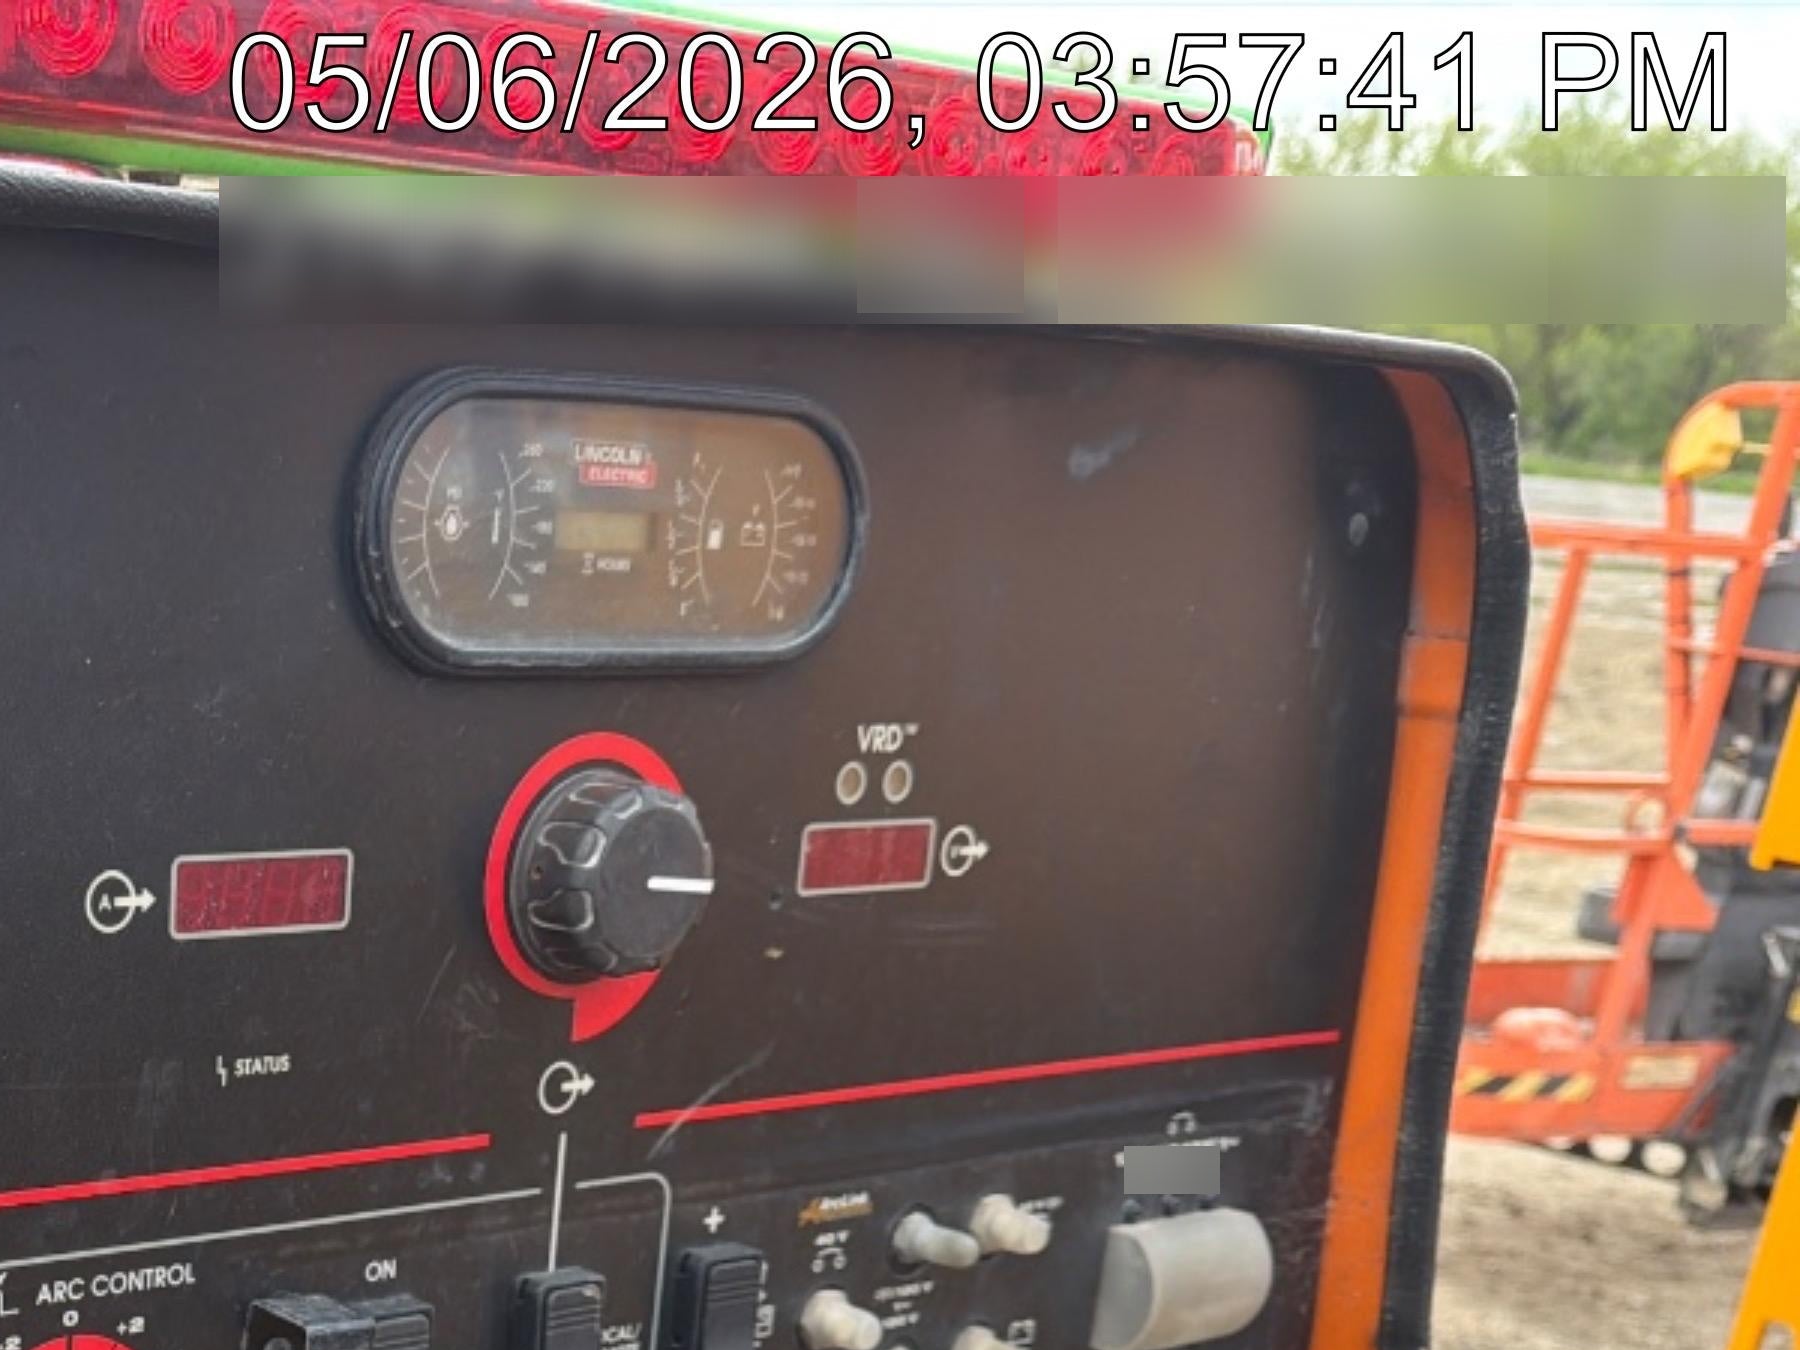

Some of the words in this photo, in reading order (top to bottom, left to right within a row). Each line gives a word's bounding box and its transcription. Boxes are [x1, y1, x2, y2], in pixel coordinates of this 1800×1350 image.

[575, 443, 641, 465] LINCOLN
[234, 1053, 291, 1078] STATUS
[366, 1259, 397, 1283] ON
[36, 1277, 85, 1306] ARC
[91, 1263, 197, 1297] CONTROL
[63, 1311, 79, 1326] 0
[117, 1317, 145, 1334] +2
